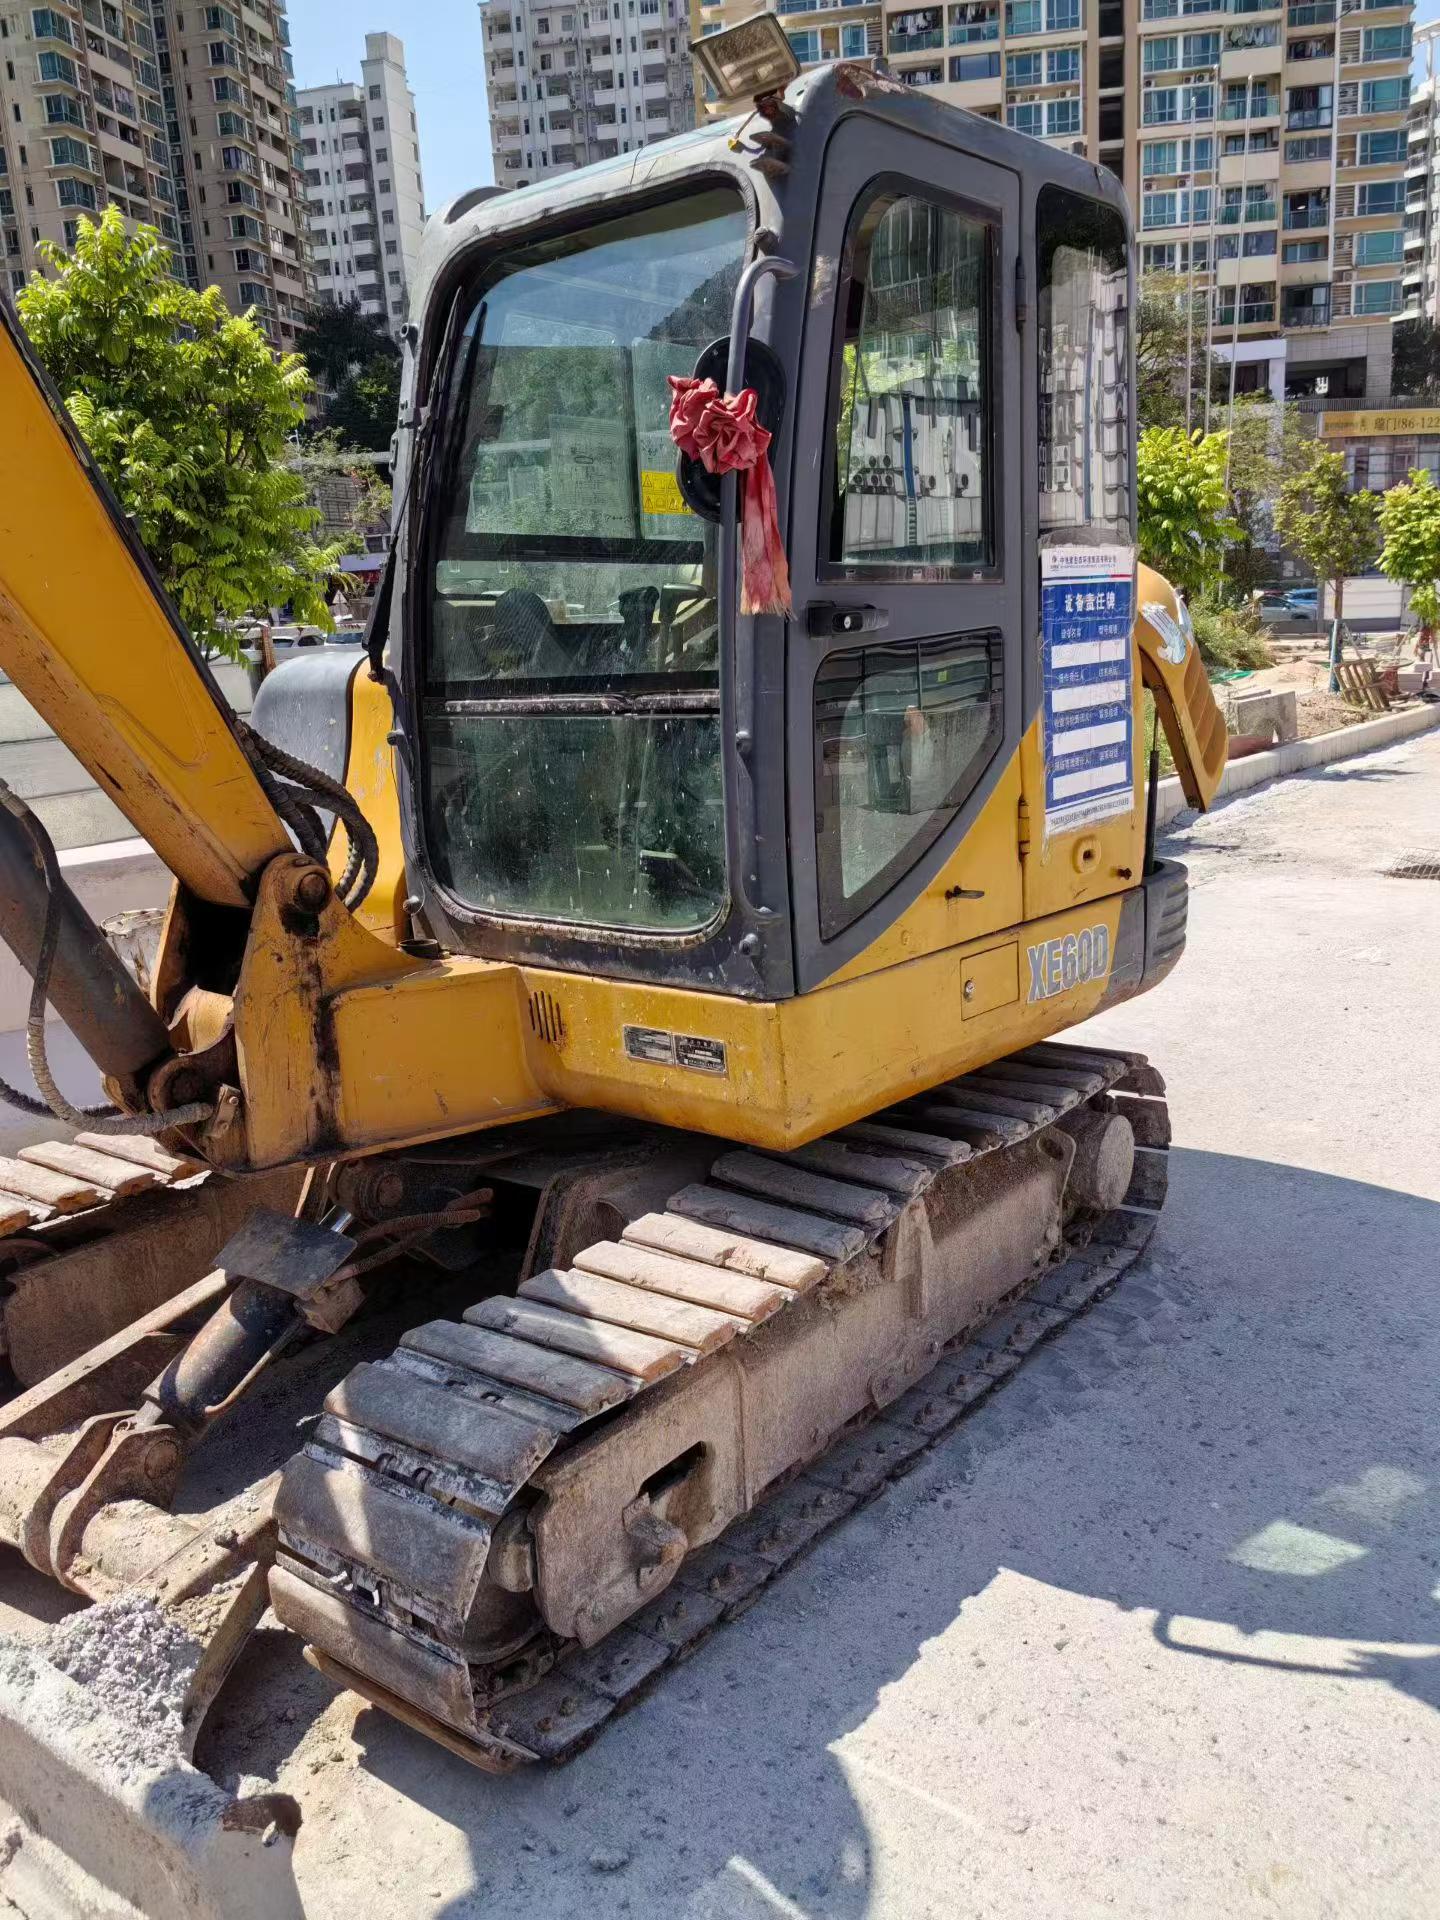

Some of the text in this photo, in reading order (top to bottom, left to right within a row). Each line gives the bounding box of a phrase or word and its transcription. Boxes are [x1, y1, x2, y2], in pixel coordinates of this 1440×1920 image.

[1064, 591, 1116, 612] 设备责任牌
[1026, 923, 1109, 1004] XE60D
